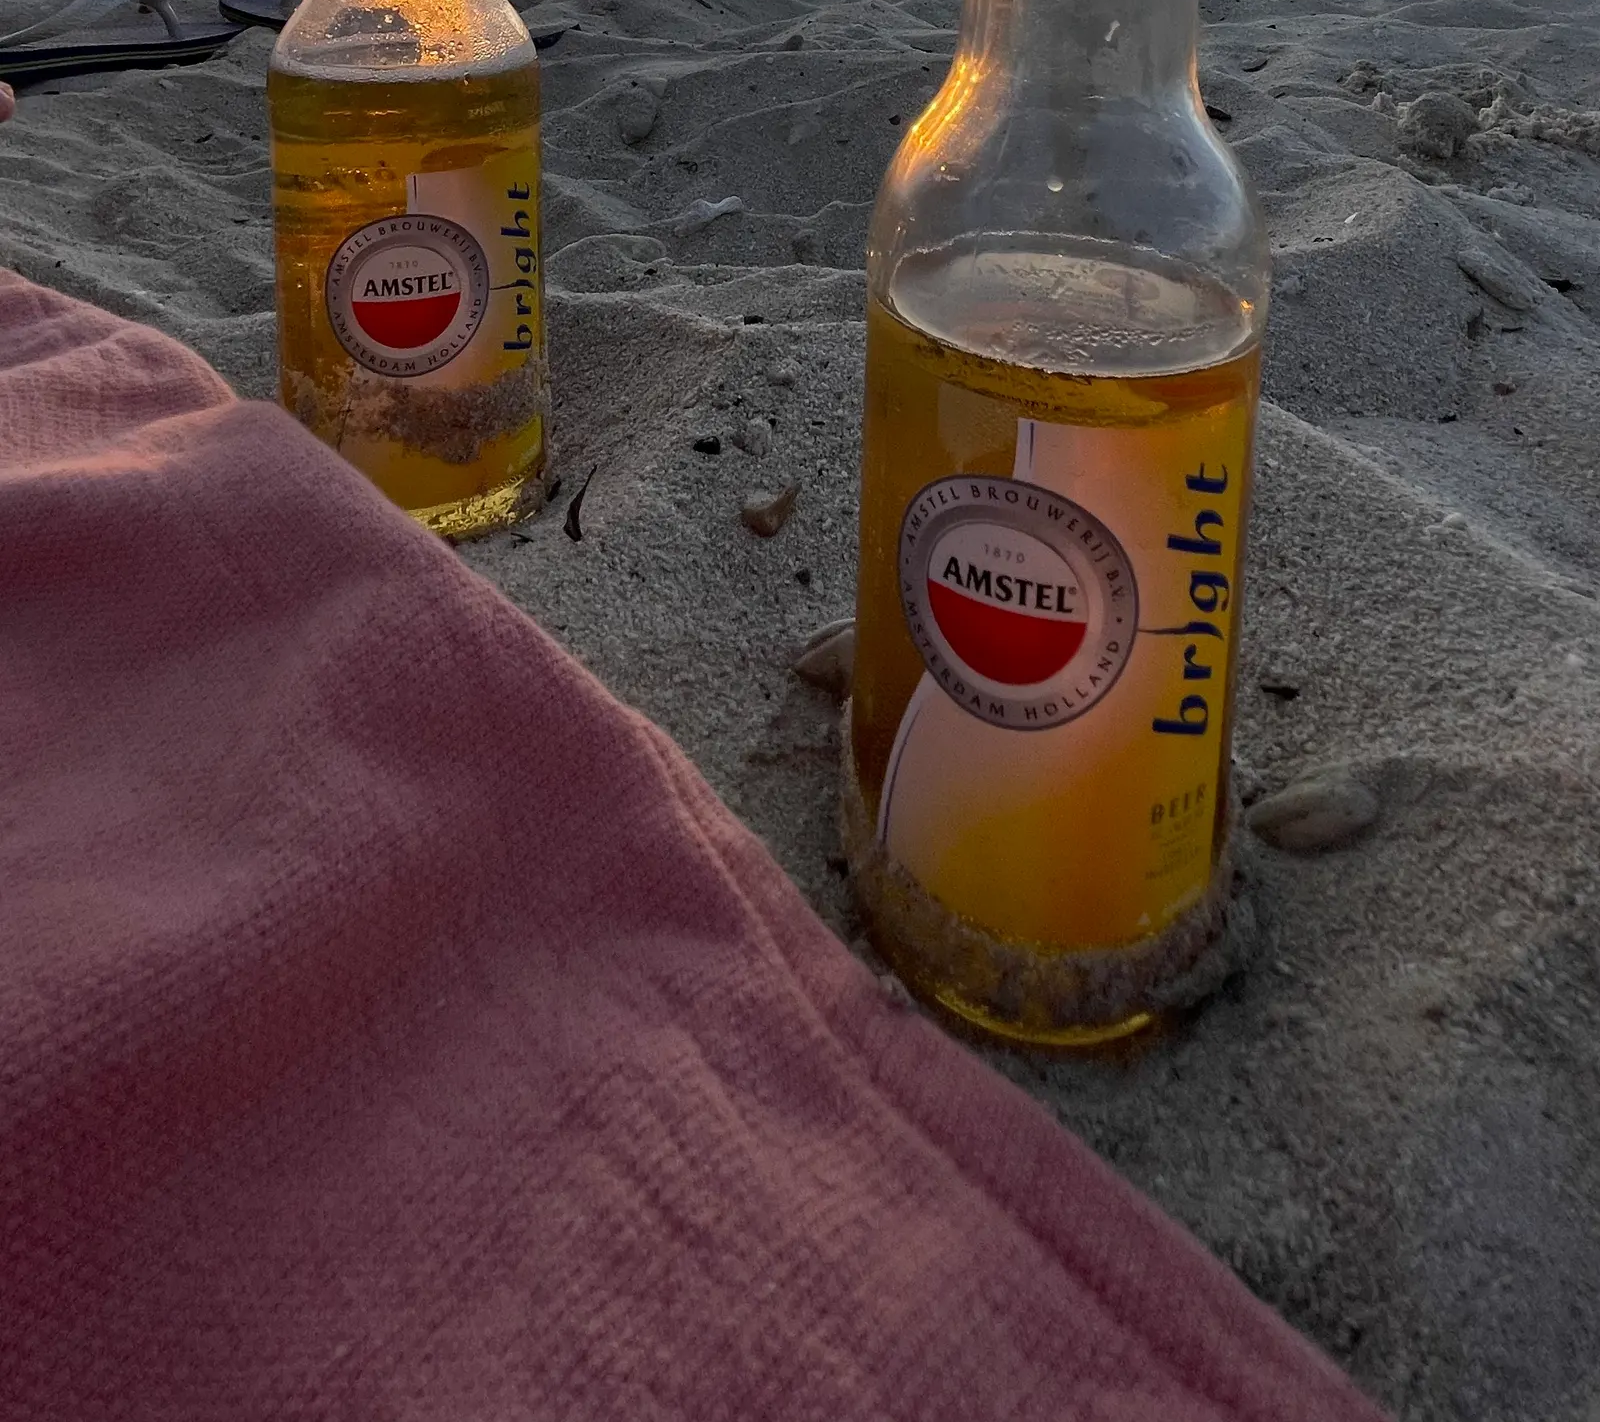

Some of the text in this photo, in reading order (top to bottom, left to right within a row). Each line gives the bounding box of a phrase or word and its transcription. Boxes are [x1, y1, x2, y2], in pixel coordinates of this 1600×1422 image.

[332, 235, 372, 286] AMSTEL
[378, 220, 470, 253] BROUWERIJ
[363, 271, 452, 298] AMSTEL
[500, 181, 537, 352] bright
[332, 298, 482, 372] AMSTERDAM HOLLAND
[905, 486, 960, 547] AMSTEL
[969, 484, 1110, 564] BROUWERIJ
[983, 542, 1026, 564] 1870
[942, 555, 1074, 615] AMSTEL
[1150, 461, 1231, 737] bright
[904, 583, 1121, 721] AMSTERDAM HOLLAND
[1150, 782, 1208, 826] BEER
